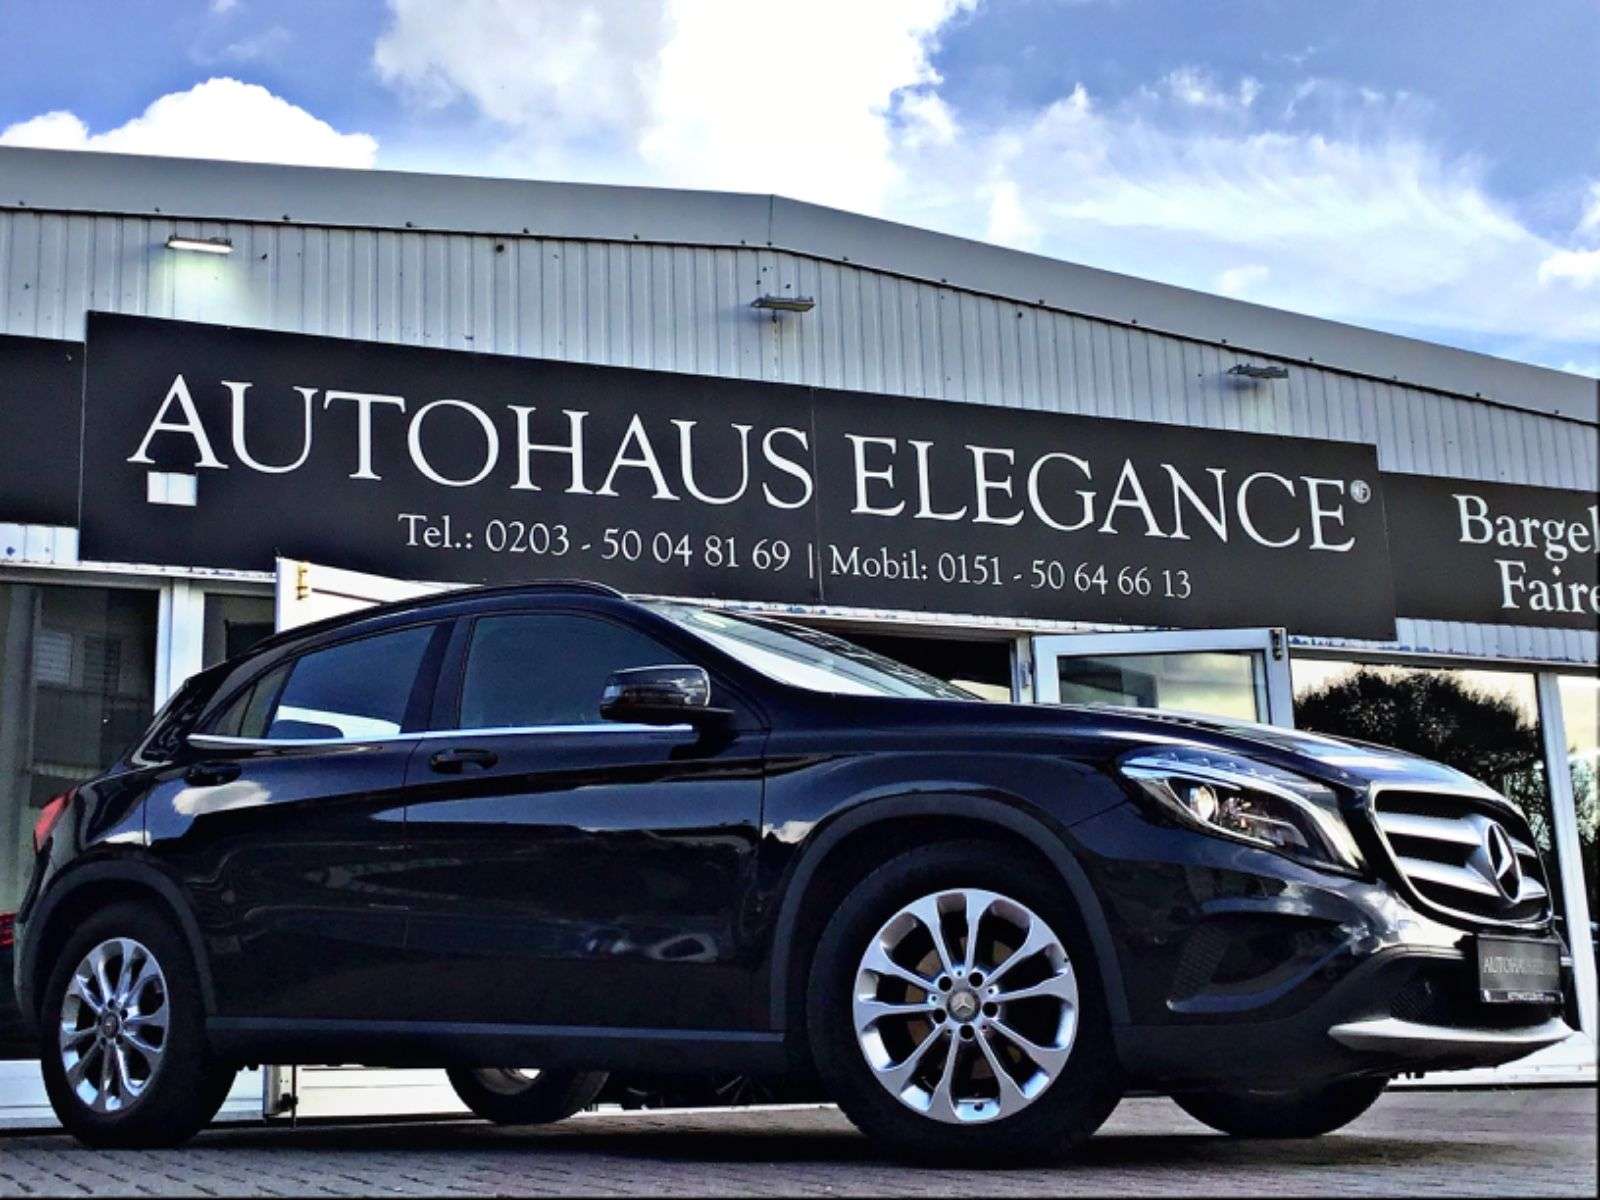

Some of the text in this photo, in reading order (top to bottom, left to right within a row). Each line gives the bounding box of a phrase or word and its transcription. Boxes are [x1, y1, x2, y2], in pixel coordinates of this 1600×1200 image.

[127, 373, 1356, 553] AUTOHAUS ELEGANCE
[398, 513, 473, 550] Tel.:
[485, 519, 570, 556] 0203
[601, 528, 642, 561] 50
[652, 531, 693, 567] 04
[704, 535, 740, 568] 81
[752, 538, 791, 572] 69
[829, 544, 928, 581] Mobil:
[938, 552, 1003, 586] 0151
[1031, 559, 1065, 590] 50
[1074, 562, 1109, 595] 64
[1117, 566, 1152, 596] 66
[1162, 569, 1191, 599] 13
